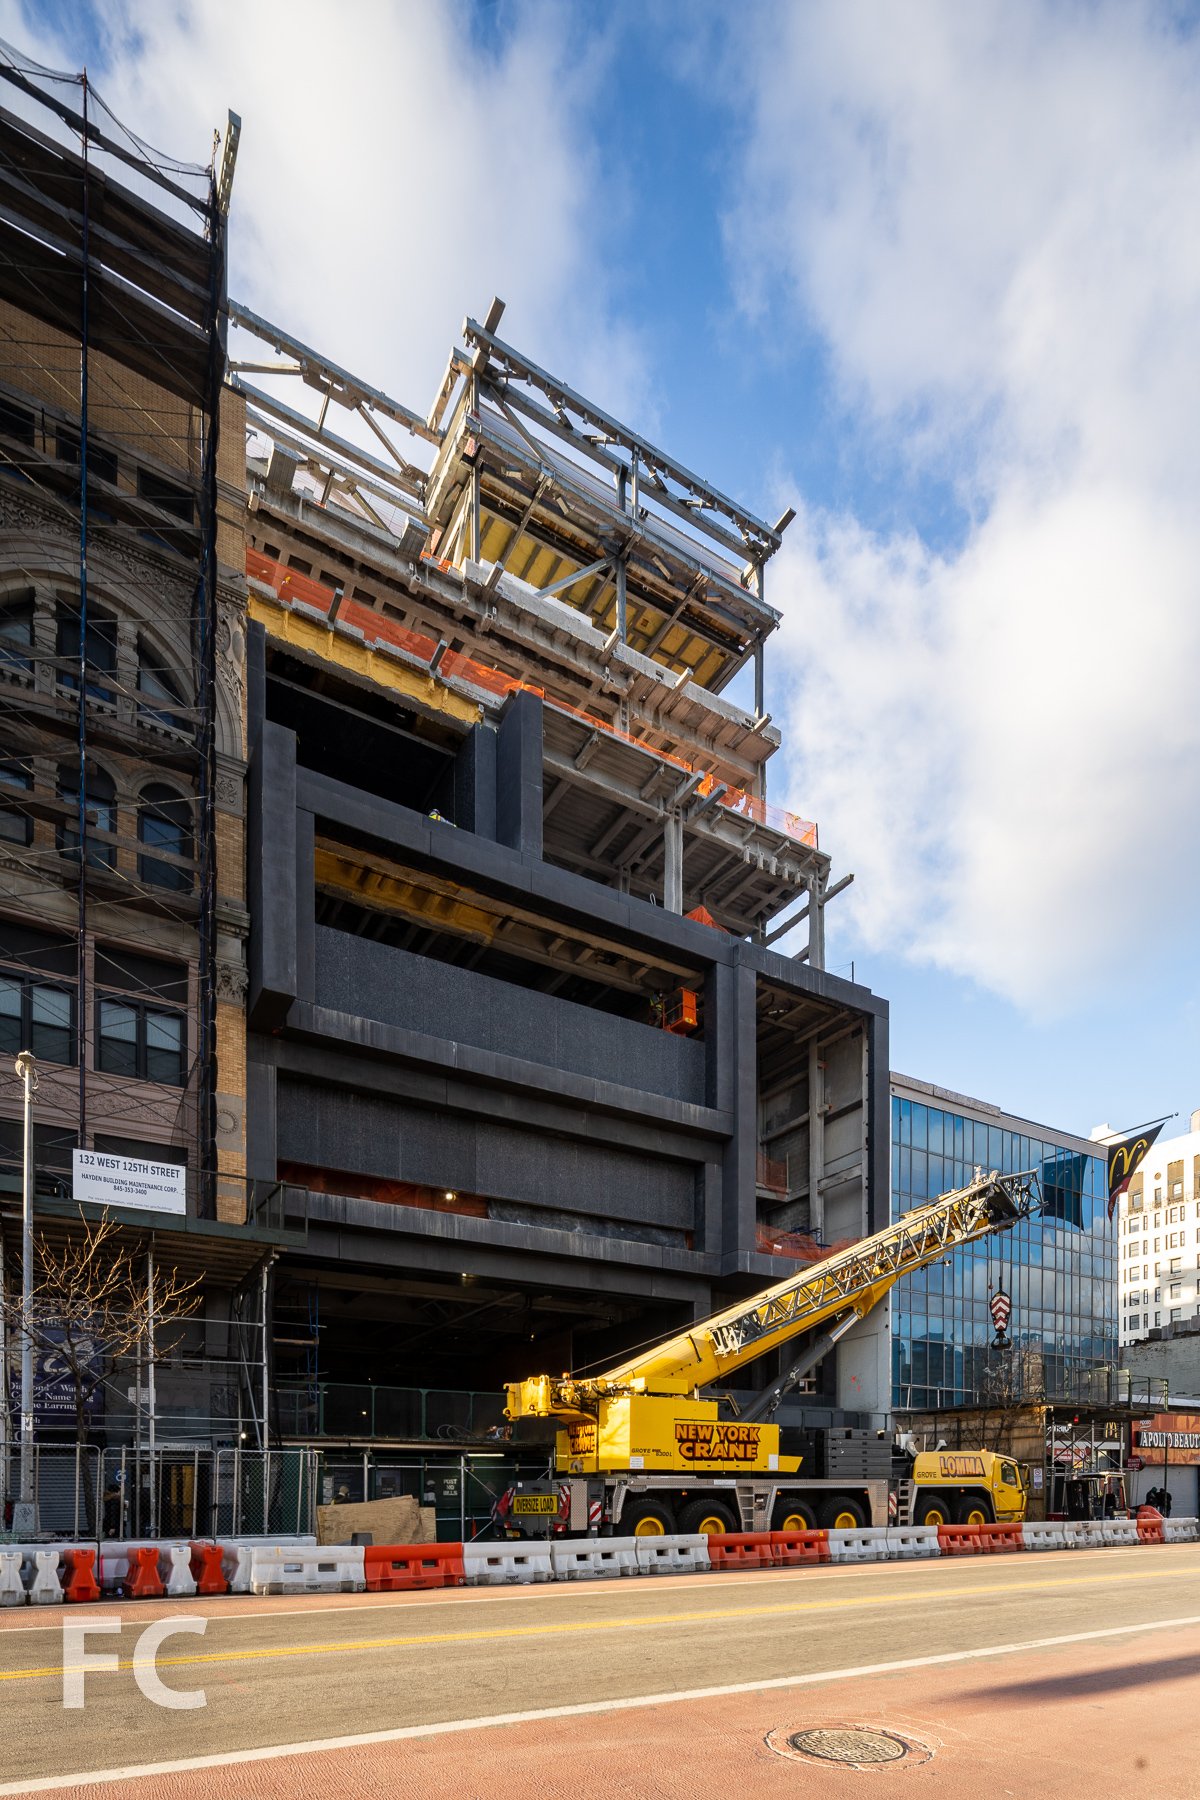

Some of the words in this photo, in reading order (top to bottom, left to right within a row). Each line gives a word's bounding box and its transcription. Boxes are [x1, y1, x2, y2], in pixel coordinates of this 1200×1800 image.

[79, 1154, 95, 1165] 132
[97, 1157, 120, 1169] WEST
[123, 1162, 149, 1174] 125TH
[150, 1166, 180, 1179] STREET
[81, 1173, 102, 1182] HAYDEN
[103, 1176, 128, 1186] BUILDING
[128, 1181, 163, 1192] MAINTENANCE
[113, 1184, 148, 1195] 845-353-3400
[675, 1424, 714, 1442] NEW
[717, 1425, 761, 1443] YORK
[1174, 1433, 1200, 1449] BEAUT
[679, 1441, 759, 1461] CRANE
[939, 1455, 986, 1478] LOMMA
[516, 1497, 539, 1512] OVERSIZE
[540, 1497, 554, 1512] LOAD
